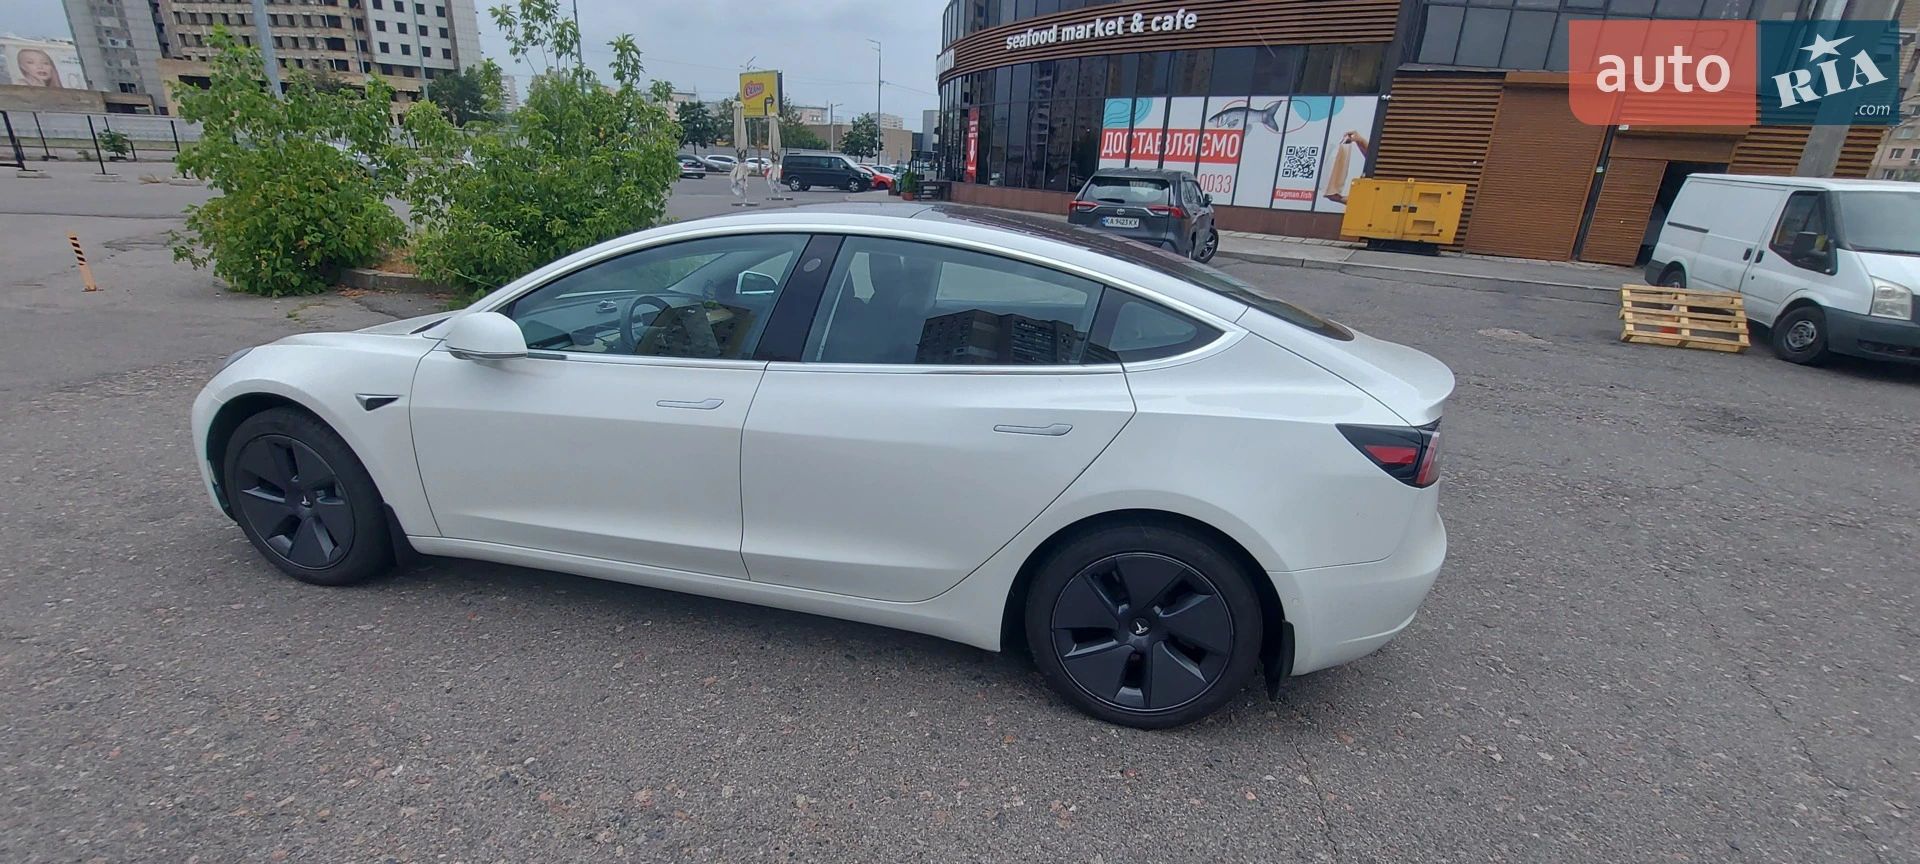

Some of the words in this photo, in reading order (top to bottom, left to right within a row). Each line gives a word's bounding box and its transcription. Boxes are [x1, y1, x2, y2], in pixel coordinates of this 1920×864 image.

[1006, 24, 1058, 49] seafood
[1061, 16, 1125, 42] market
[1131, 12, 1144, 33] &
[1151, 8, 1197, 32] cafe
[1101, 131, 1240, 158] ДОСТАВЛЯЄМО
